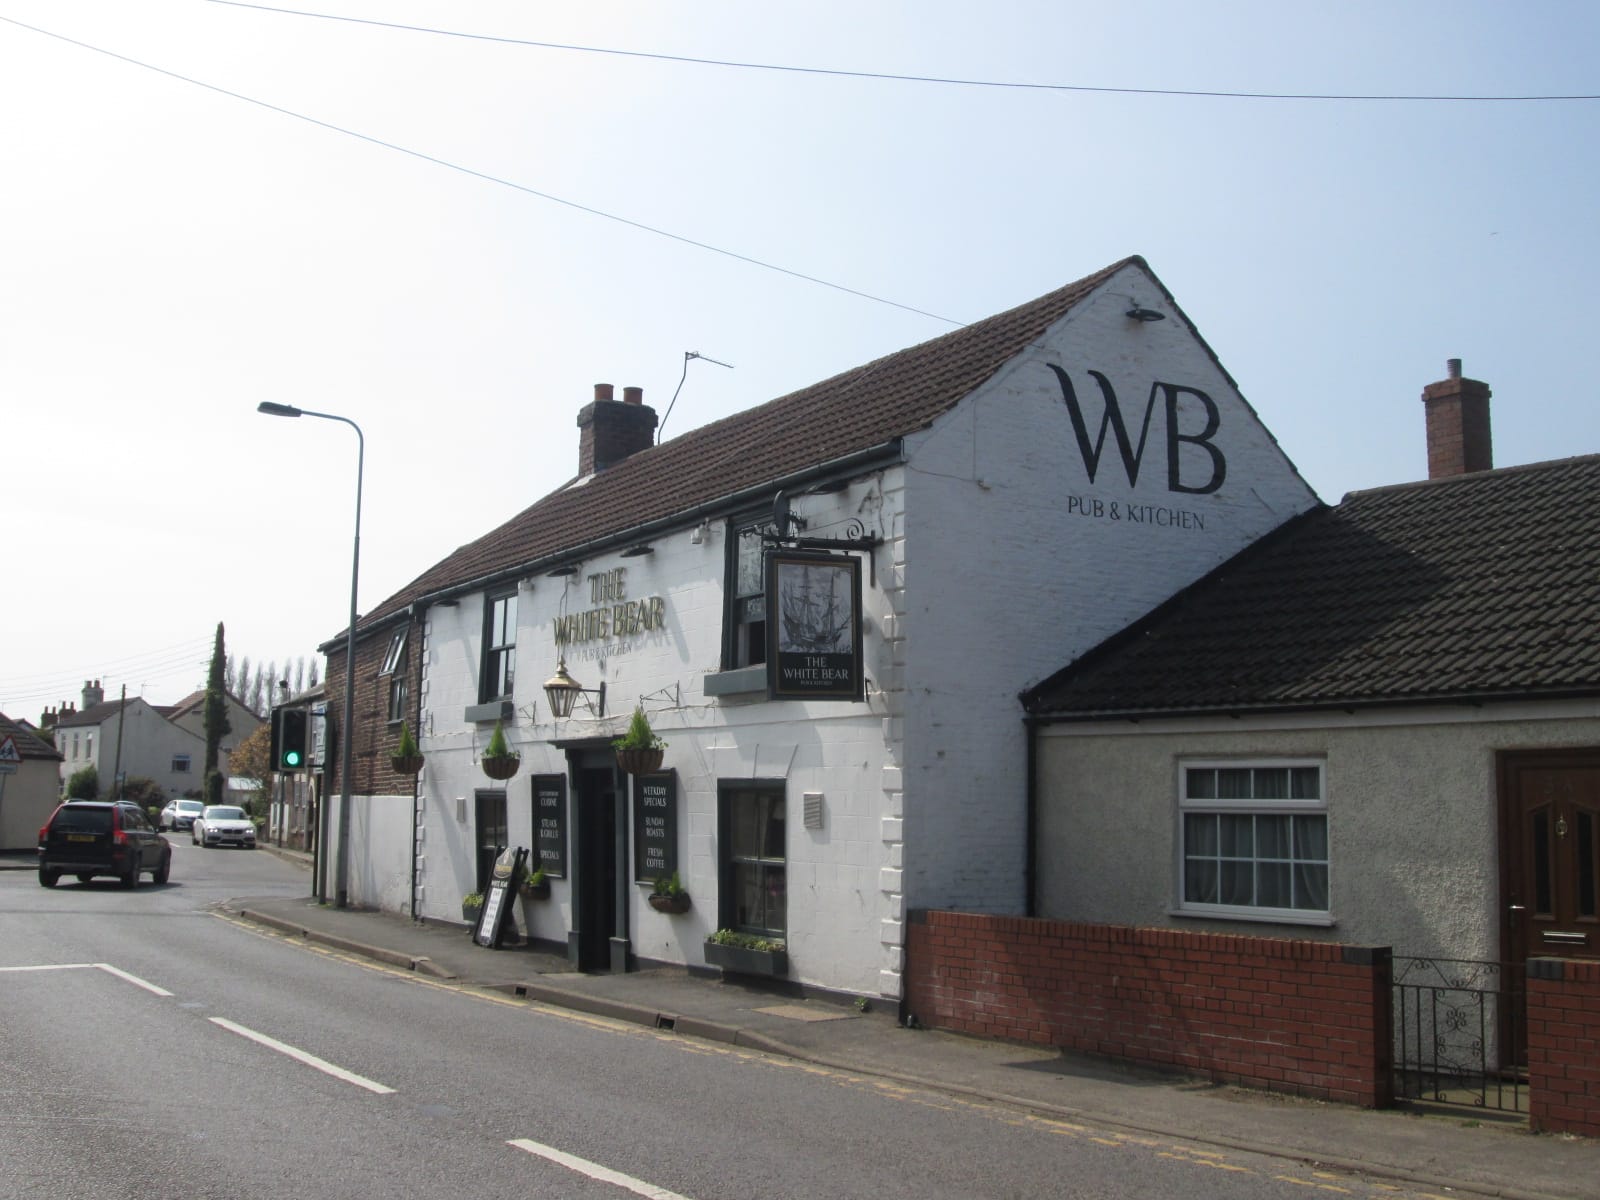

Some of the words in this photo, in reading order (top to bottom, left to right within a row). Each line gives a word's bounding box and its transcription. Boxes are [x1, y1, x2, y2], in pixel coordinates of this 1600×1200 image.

[1046, 363, 1226, 494] WB
[1067, 495, 1104, 517] PUB
[1109, 501, 1120, 521] &
[1127, 503, 1205, 531] KITCHEN
[587, 567, 627, 604] THE
[553, 607, 611, 646] WHITE
[613, 596, 665, 637] BEAR
[804, 656, 827, 668] THE
[784, 668, 819, 680] WHITE
[821, 668, 849, 680] BEAR
[643, 786, 666, 796] WEEKDAY
[643, 797, 667, 807] SPECIALS
[645, 816, 664, 826] SUNDAY
[646, 827, 665, 838] ROASTS
[540, 849, 560, 860] SPECIALS
[647, 847, 663, 858] FRESH
[646, 858, 665, 869] COFFEE
